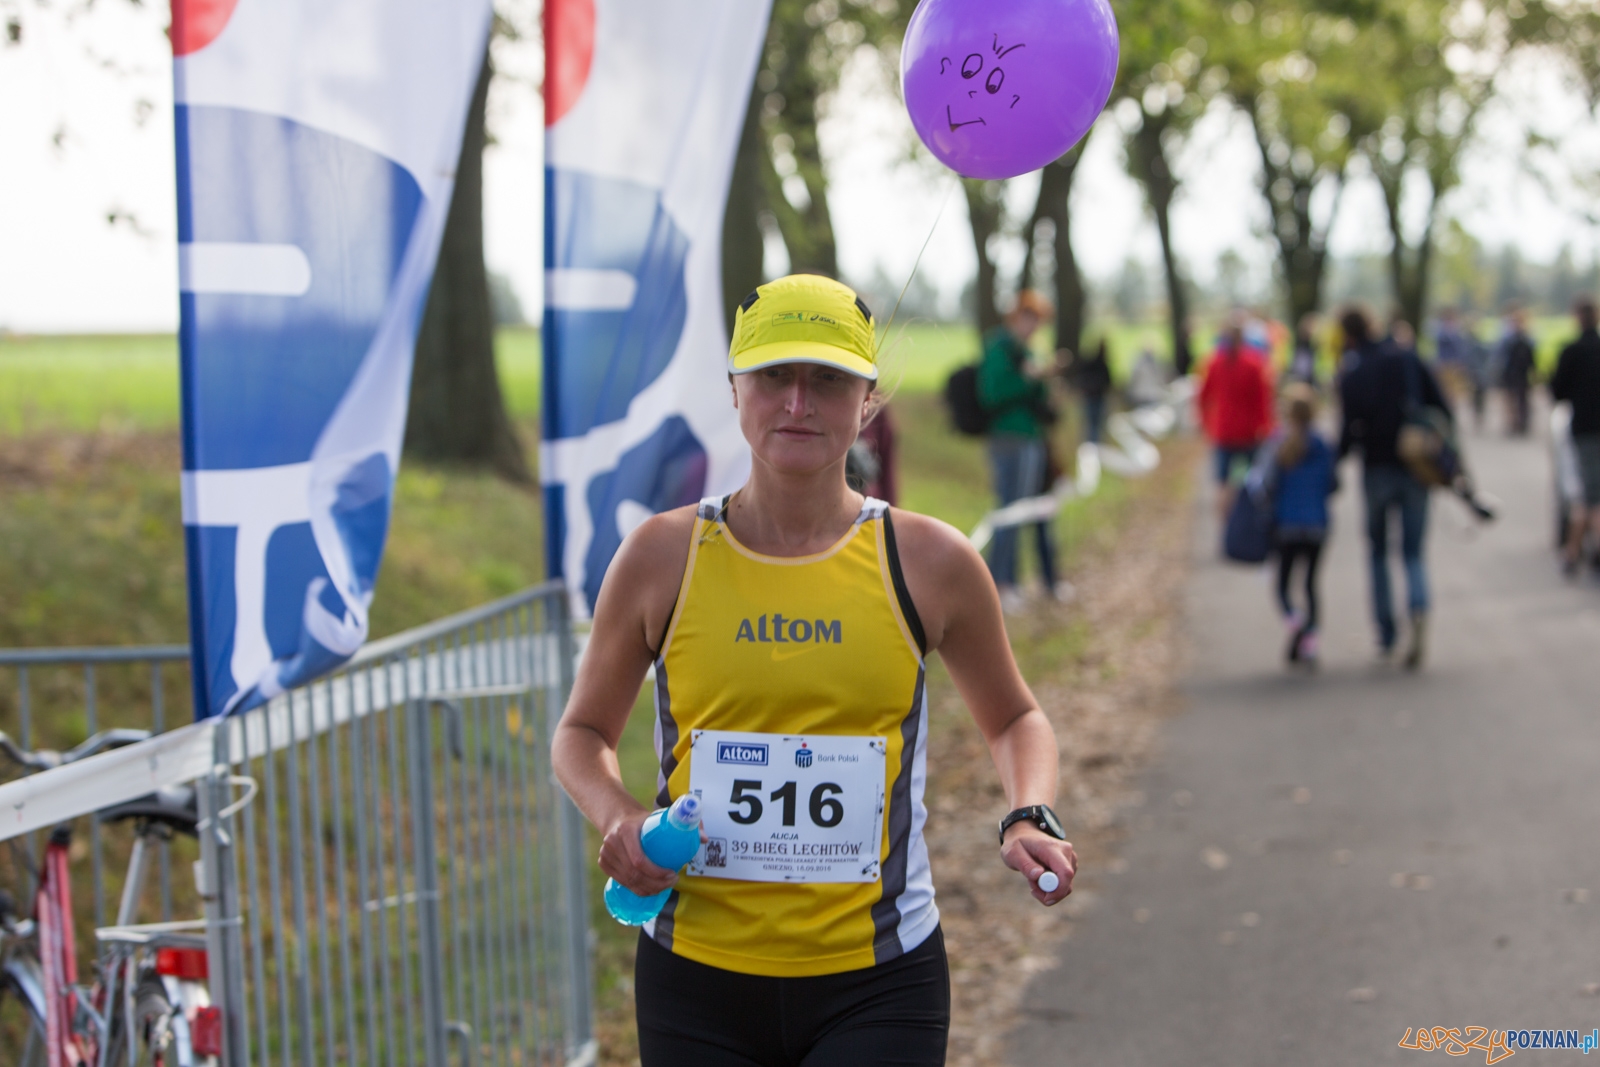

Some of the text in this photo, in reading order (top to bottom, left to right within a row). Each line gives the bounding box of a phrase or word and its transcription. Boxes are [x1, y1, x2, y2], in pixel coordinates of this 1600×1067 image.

[819, 316, 836, 325] asics
[818, 754, 859, 763] Bank Polski
[728, 779, 844, 828] 516
[732, 840, 862, 855] 39 BIEG LECHITÓW
